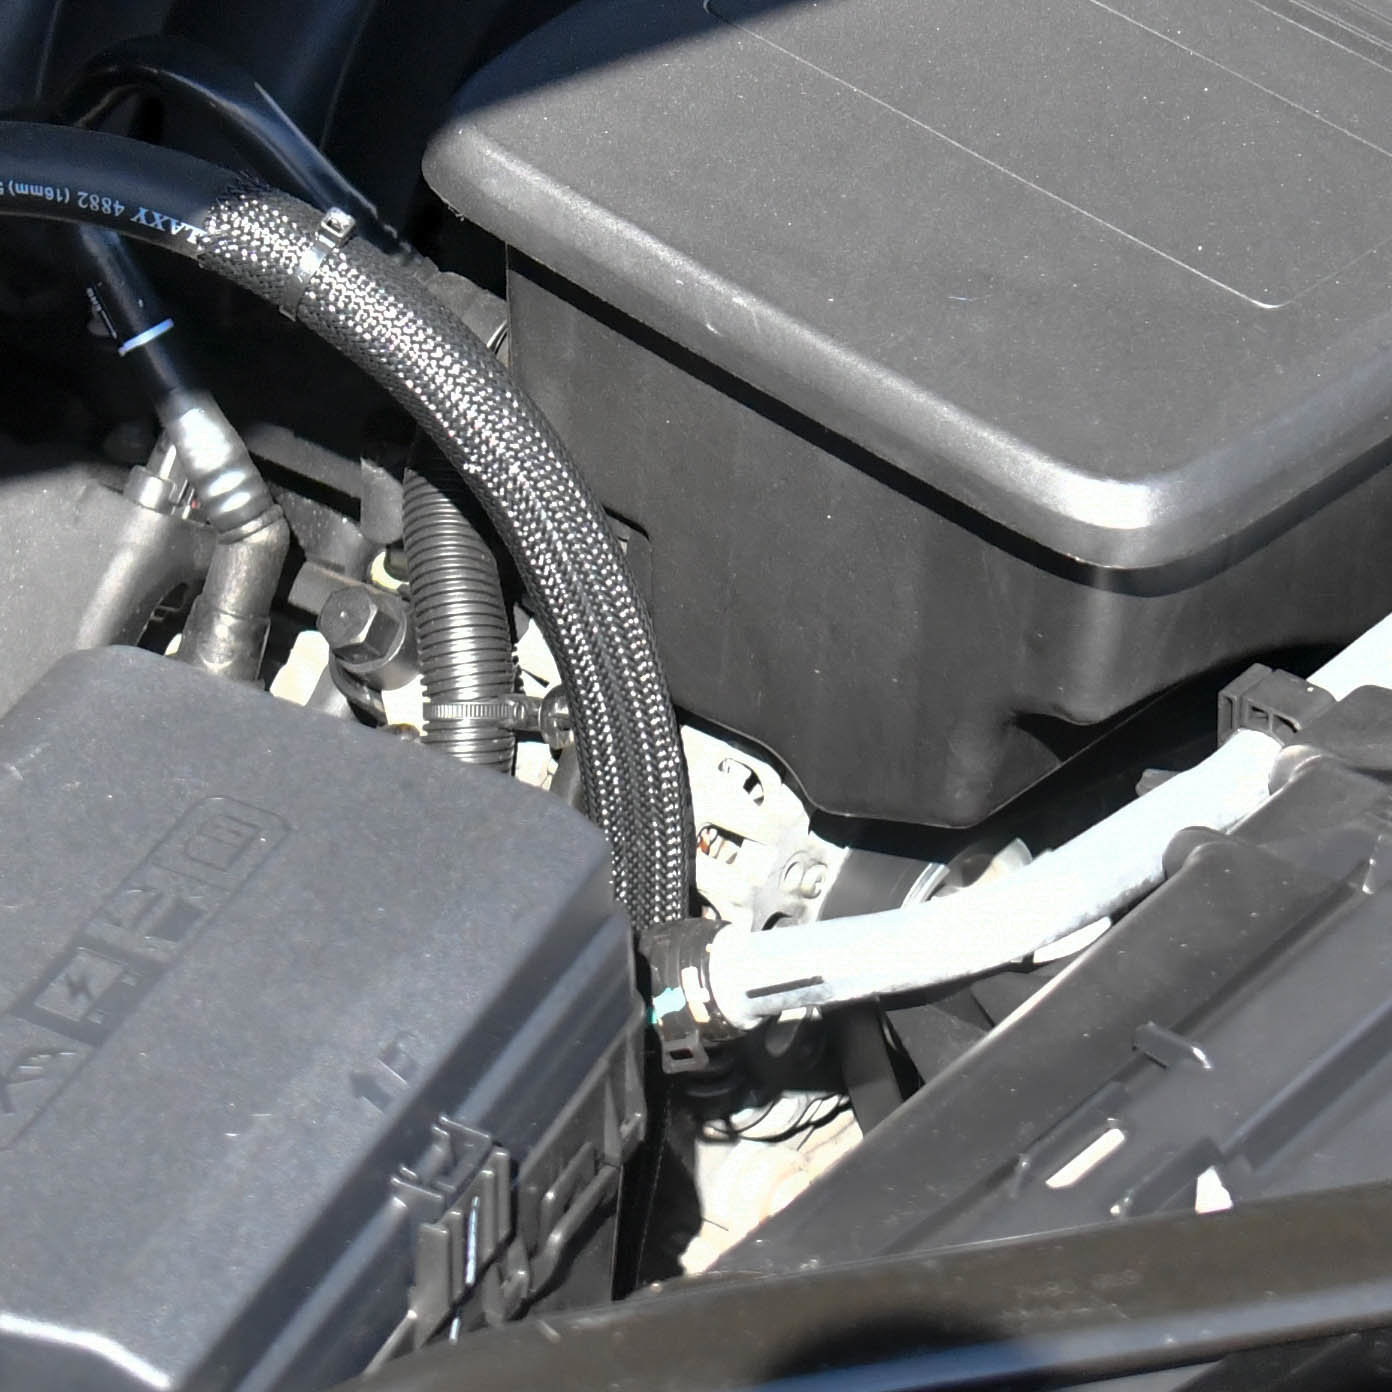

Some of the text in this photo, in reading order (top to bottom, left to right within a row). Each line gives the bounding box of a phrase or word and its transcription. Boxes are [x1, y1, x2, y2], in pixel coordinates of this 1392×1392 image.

[8, 179, 70, 204] (16mm)
[77, 191, 125, 217] 4882
[130, 207, 208, 244] LAXY
